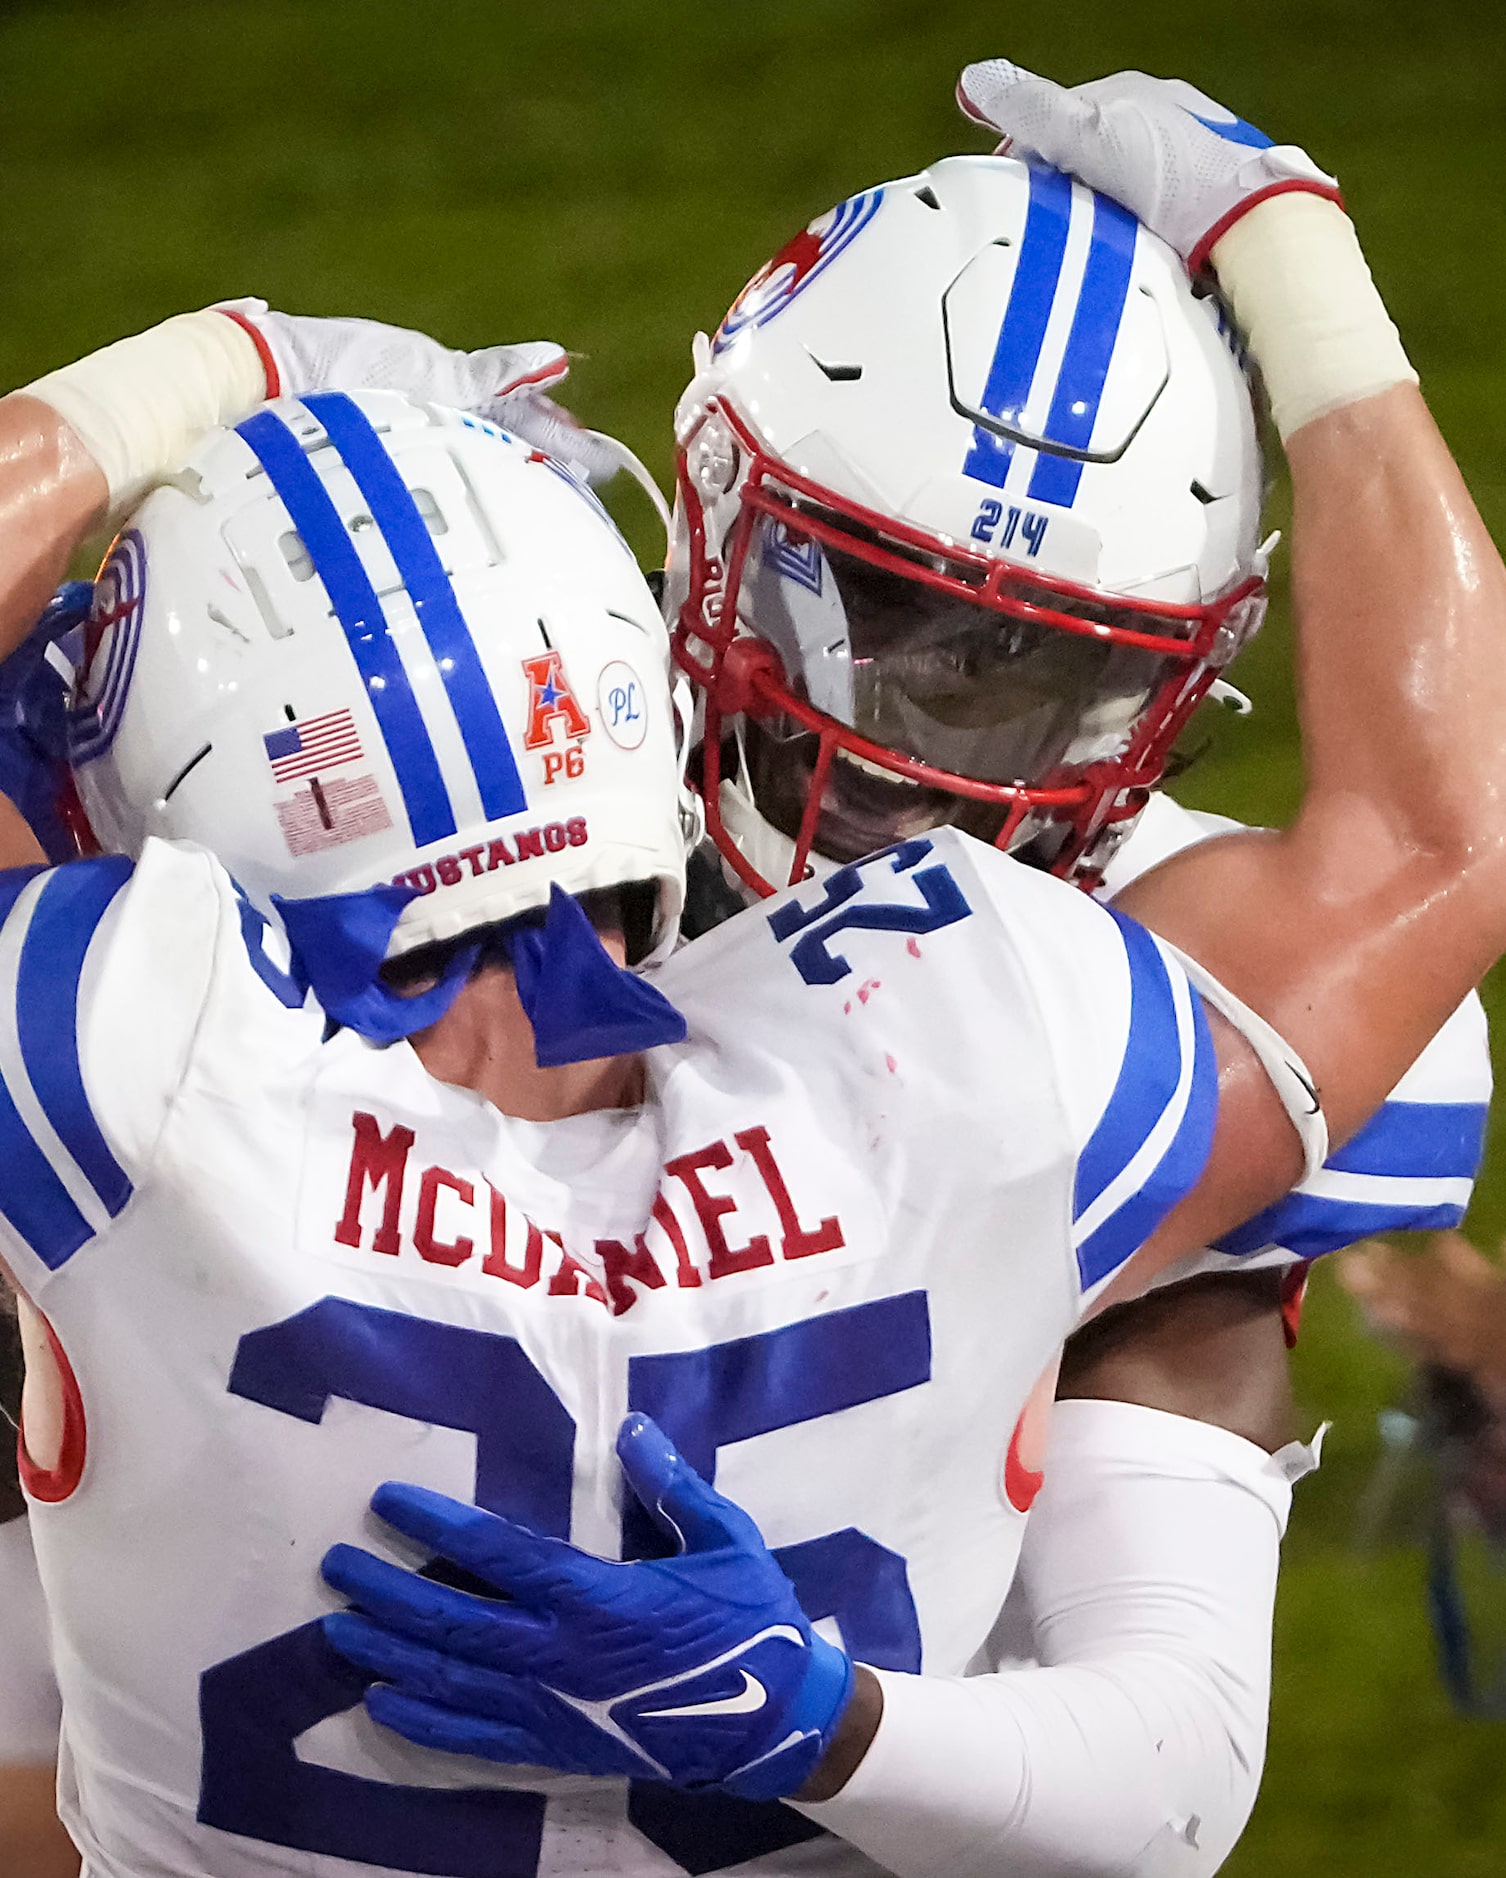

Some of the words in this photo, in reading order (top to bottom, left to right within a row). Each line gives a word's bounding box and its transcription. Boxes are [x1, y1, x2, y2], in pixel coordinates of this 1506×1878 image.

[970, 498, 1048, 557] 214
[542, 746, 584, 785] P6
[196, 1289, 932, 1878] 25
